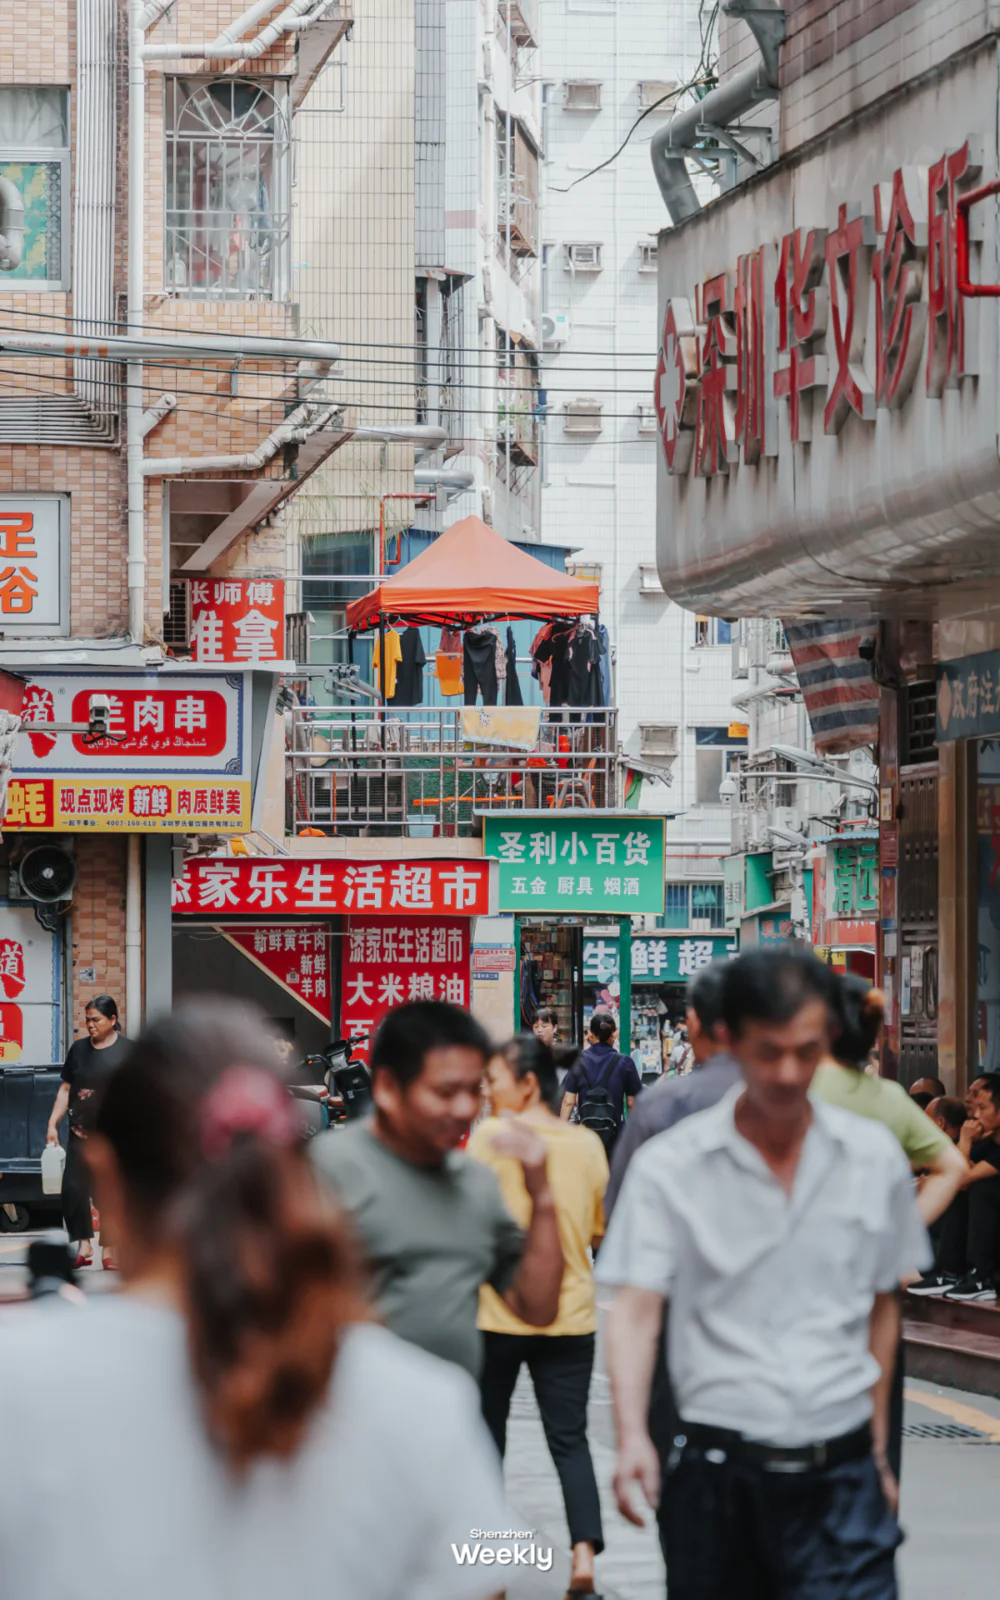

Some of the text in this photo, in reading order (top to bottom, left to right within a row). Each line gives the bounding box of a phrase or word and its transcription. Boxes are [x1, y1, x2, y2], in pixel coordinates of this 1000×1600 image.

[60, 787, 242, 815] 现点现烤 新鲜 肉质鲜美
[498, 831, 651, 867] 圣利小百货
[511, 877, 640, 896] 五金 厨具 烟酒
[254, 928, 326, 953] 新鲜黄牛肉
[300, 954, 326, 975] 新鲜
[301, 977, 326, 998] 羊肉
[346, 972, 465, 1006] 大米粮油
